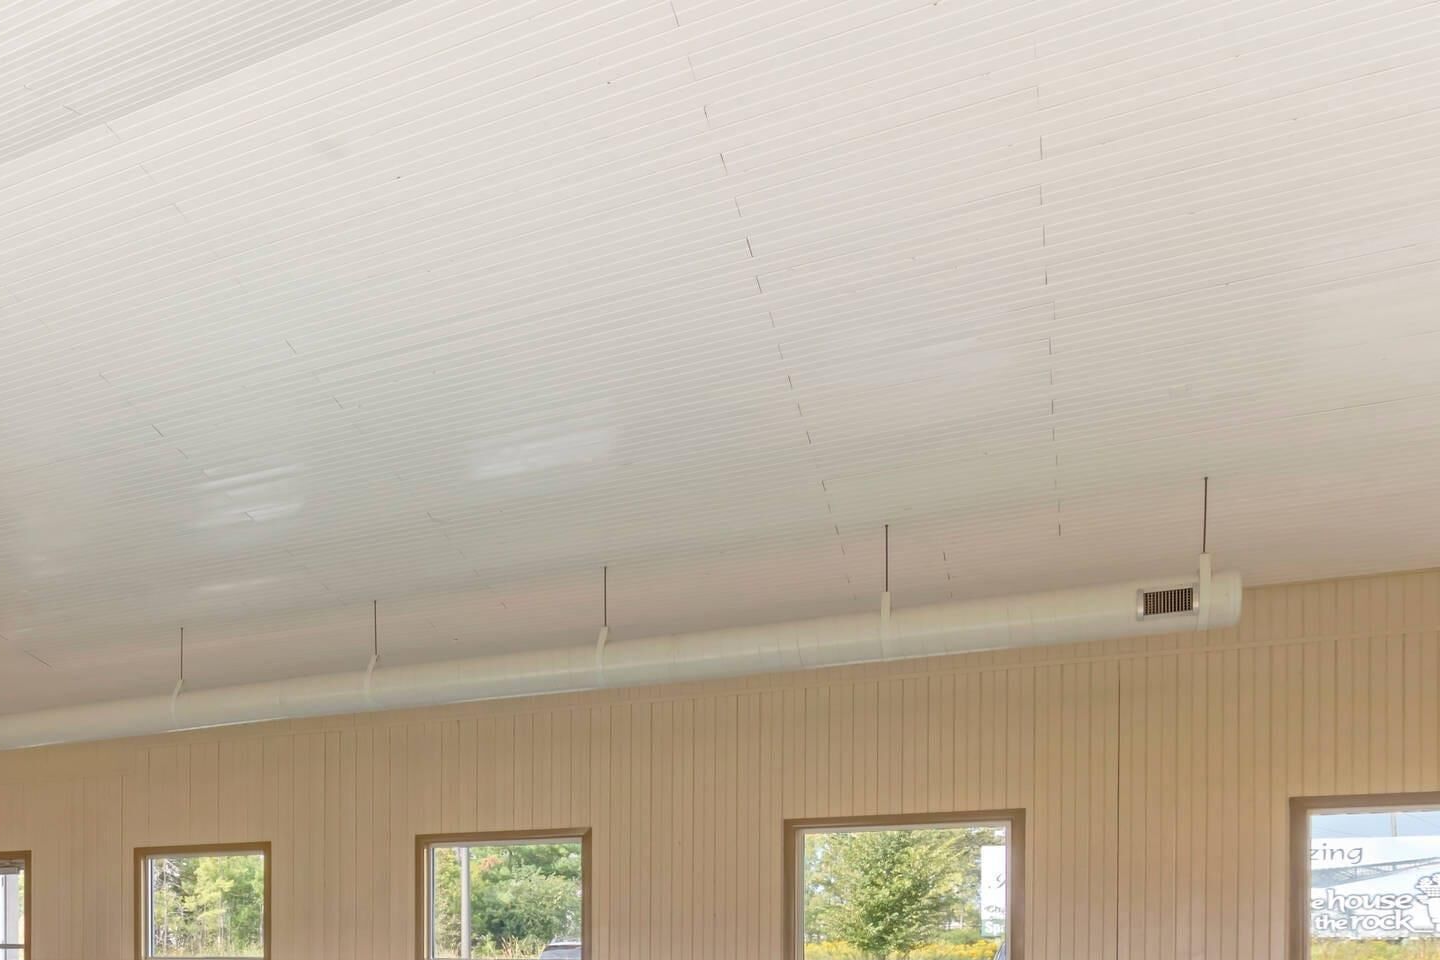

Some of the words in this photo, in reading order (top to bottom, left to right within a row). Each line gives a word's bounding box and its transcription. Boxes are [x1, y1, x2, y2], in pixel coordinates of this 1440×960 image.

[1326, 887, 1414, 914] house
[1314, 912, 1349, 932] the
[1349, 908, 1418, 932] rock
